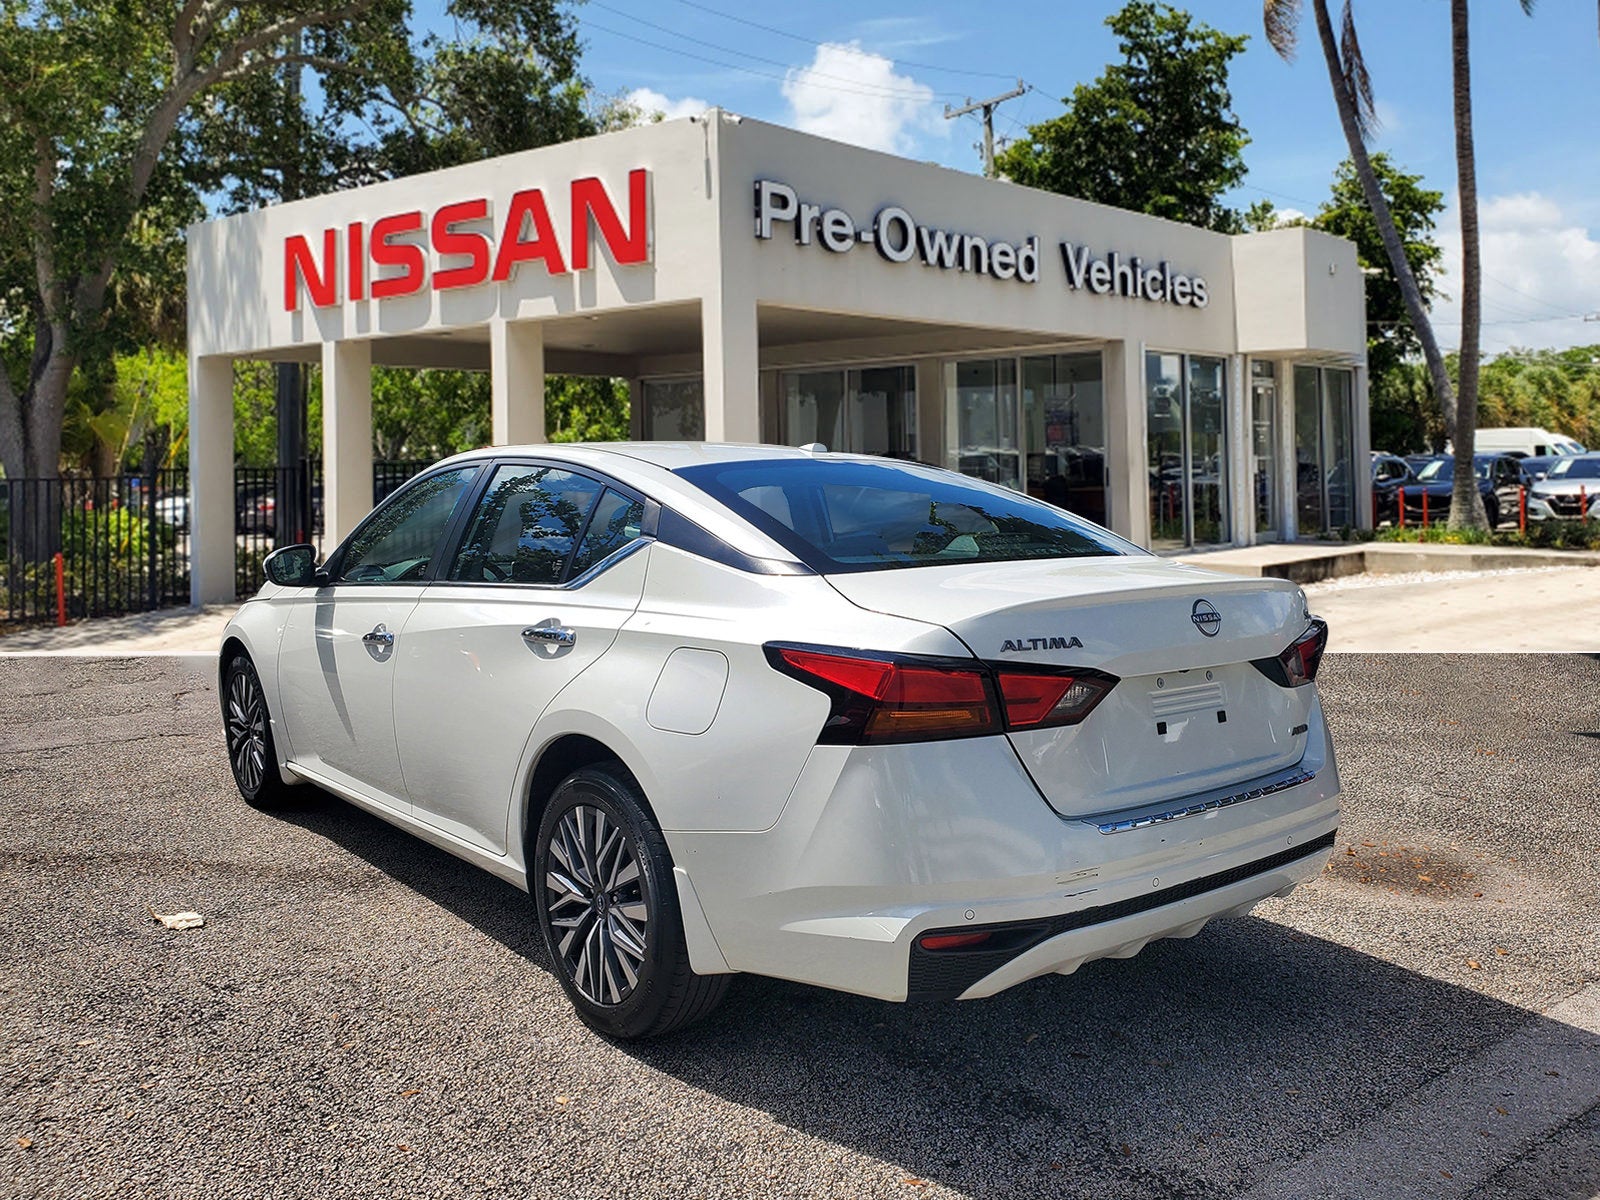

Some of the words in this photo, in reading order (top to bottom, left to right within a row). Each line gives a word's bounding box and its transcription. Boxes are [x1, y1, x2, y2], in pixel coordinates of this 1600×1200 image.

[285, 168, 648, 312] NISSAN
[754, 180, 1040, 283] Pre-Owned
[1060, 242, 1209, 308] Vehicles
[1000, 637, 1083, 652] ALTIMA
